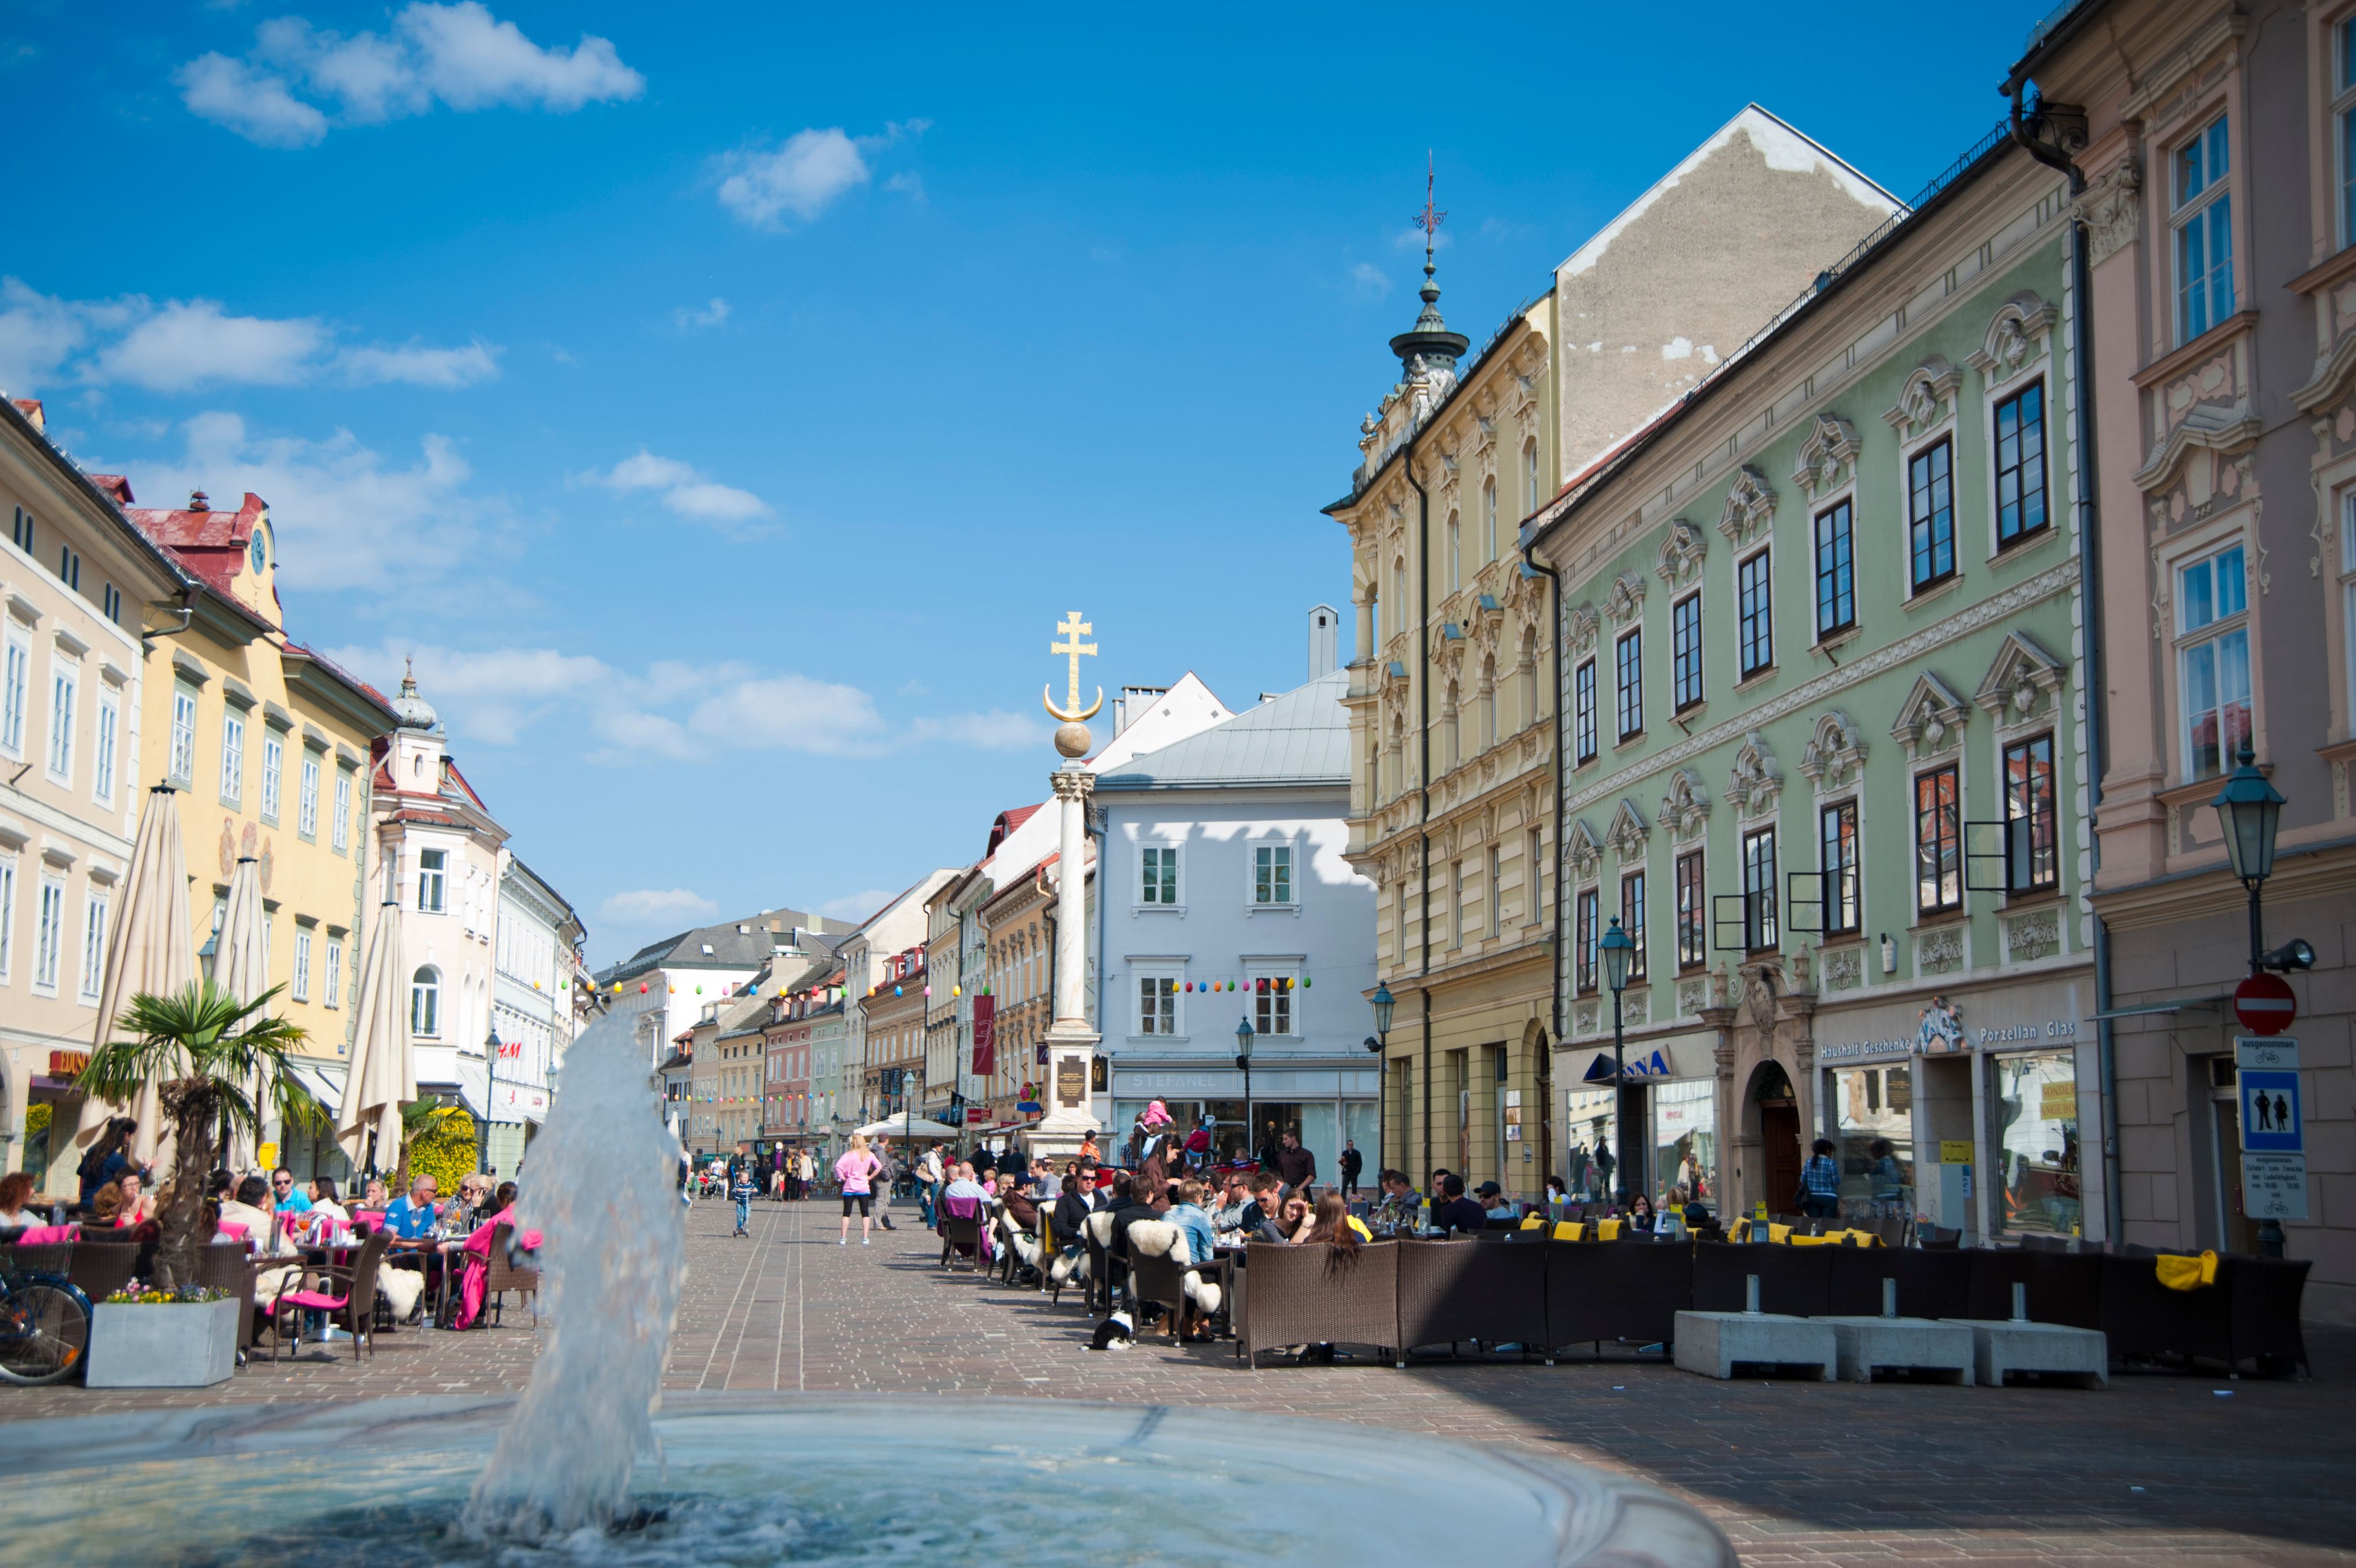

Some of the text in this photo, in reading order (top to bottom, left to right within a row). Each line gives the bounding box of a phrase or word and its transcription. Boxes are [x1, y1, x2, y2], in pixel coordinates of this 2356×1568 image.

[1980, 1020, 2074, 1043] Porzellan Glas
[1821, 1037, 1911, 1058] Haushalt Geschenke
[2242, 1040, 2294, 1050] ausgenommen
[1133, 1074, 1217, 1087] STEFANEL
